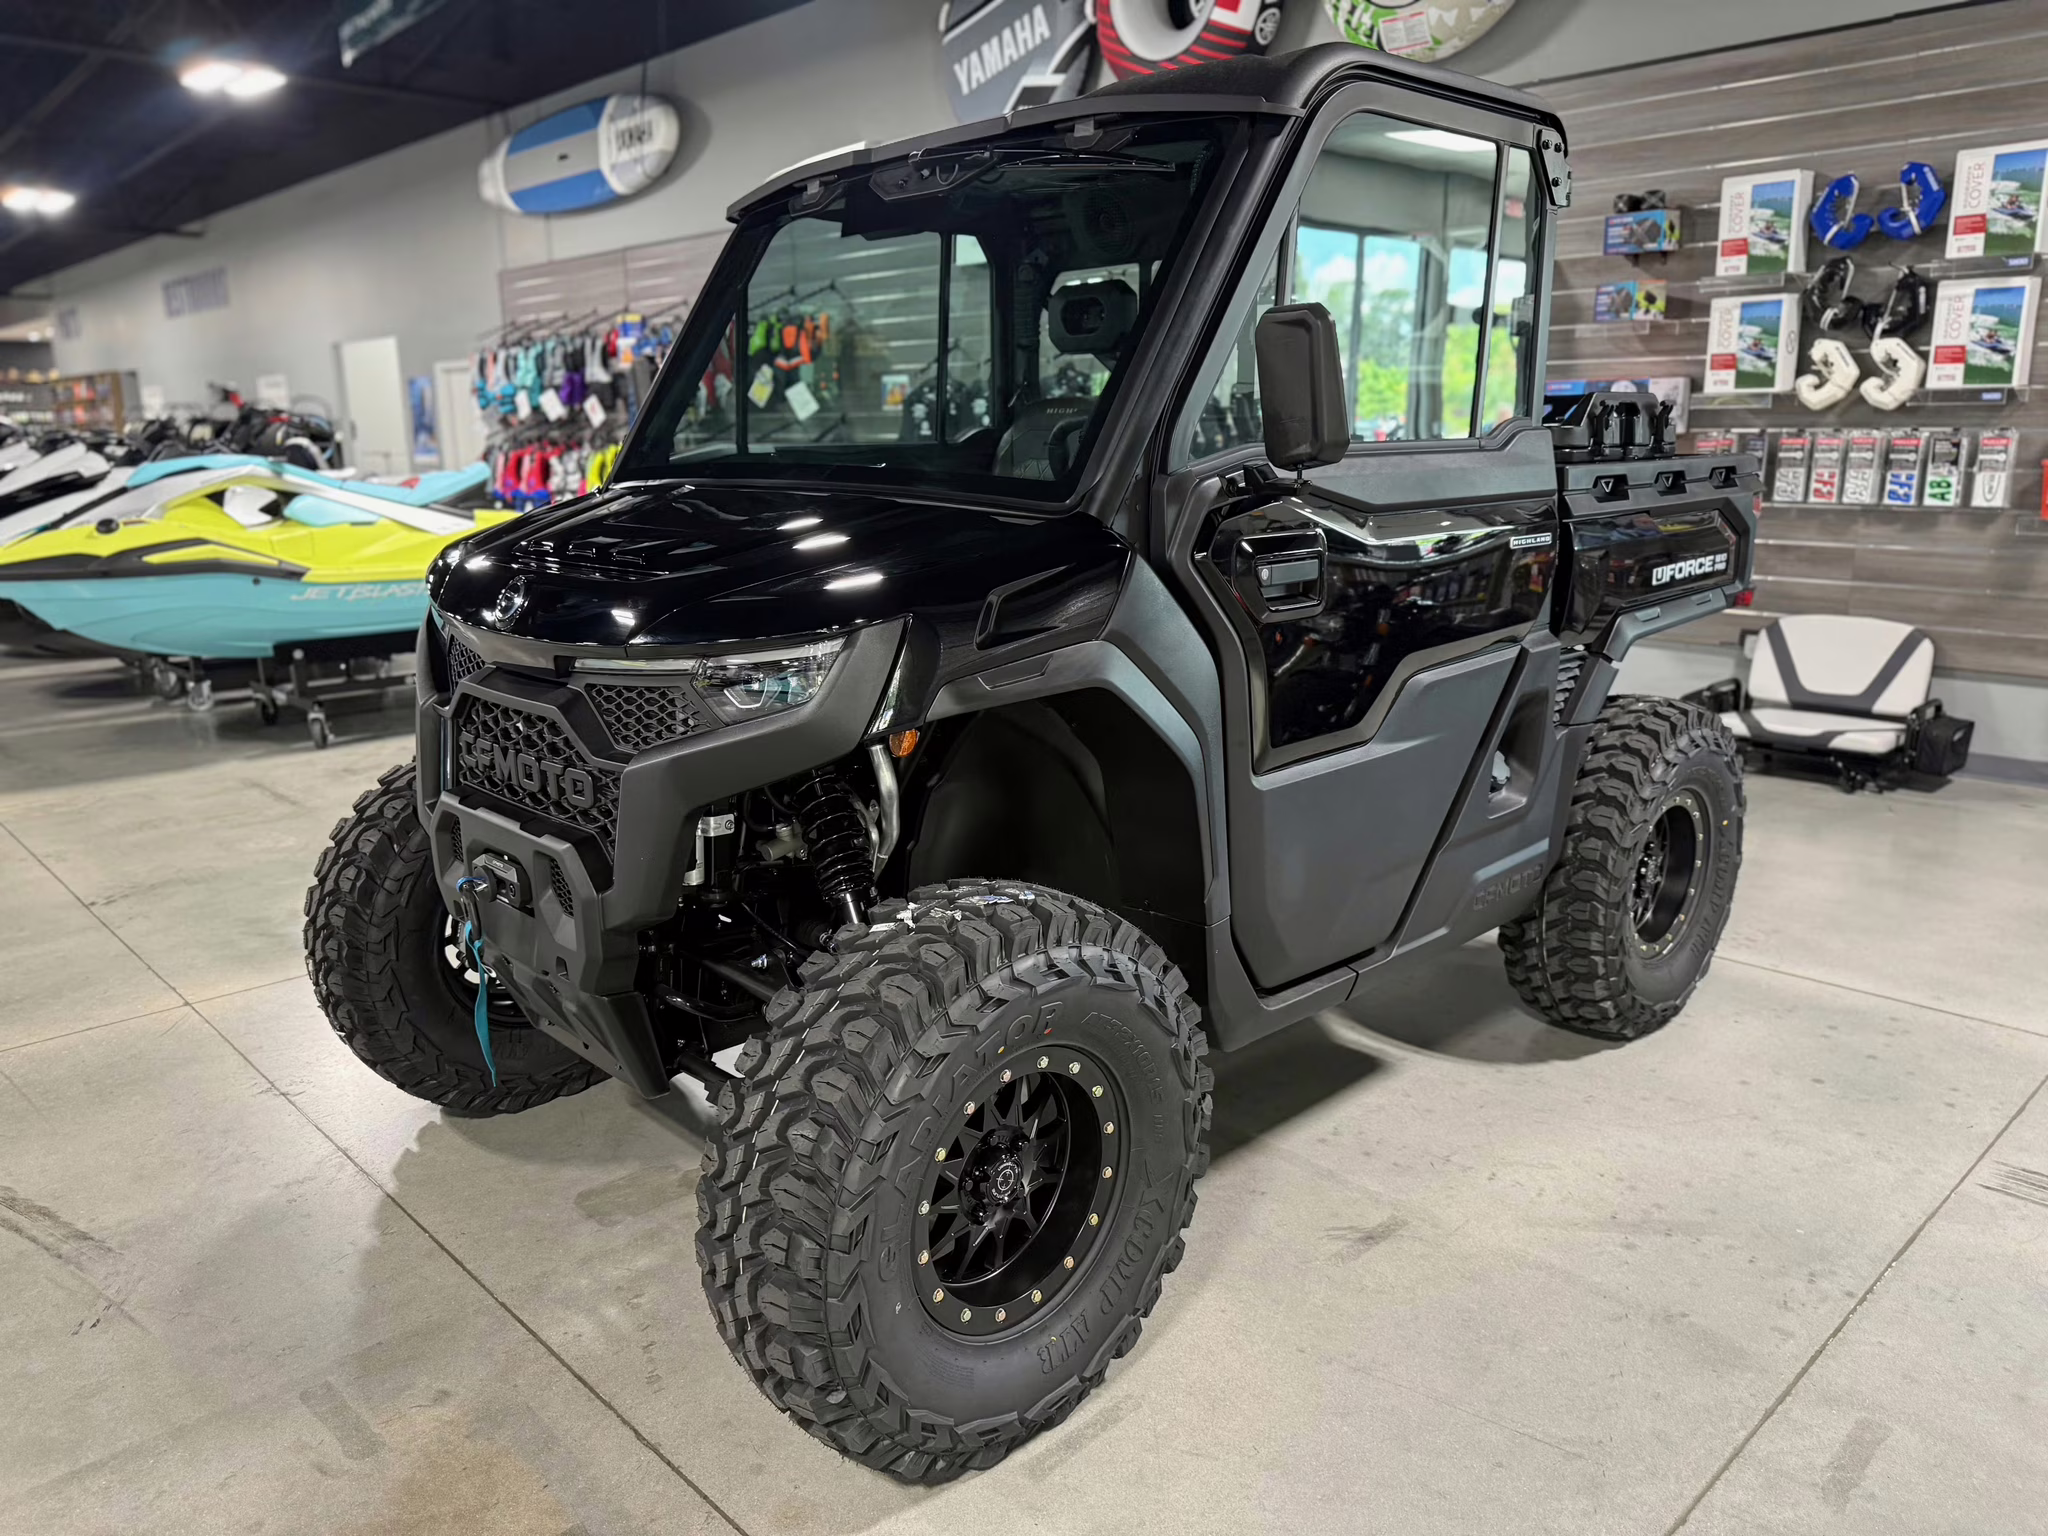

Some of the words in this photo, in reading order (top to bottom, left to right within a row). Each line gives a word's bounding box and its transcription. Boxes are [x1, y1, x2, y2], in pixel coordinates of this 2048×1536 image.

[952, 4, 1052, 96] YAMAHA
[1967, 160, 1986, 209] COVER
[1512, 535, 1551, 546] HIGHLAND
[290, 583, 426, 602] JETBLAST
[459, 730, 595, 810] CFMOTO
[1473, 863, 1543, 911] CFMOTO
[879, 1001, 1064, 1282] GLADIATOR
